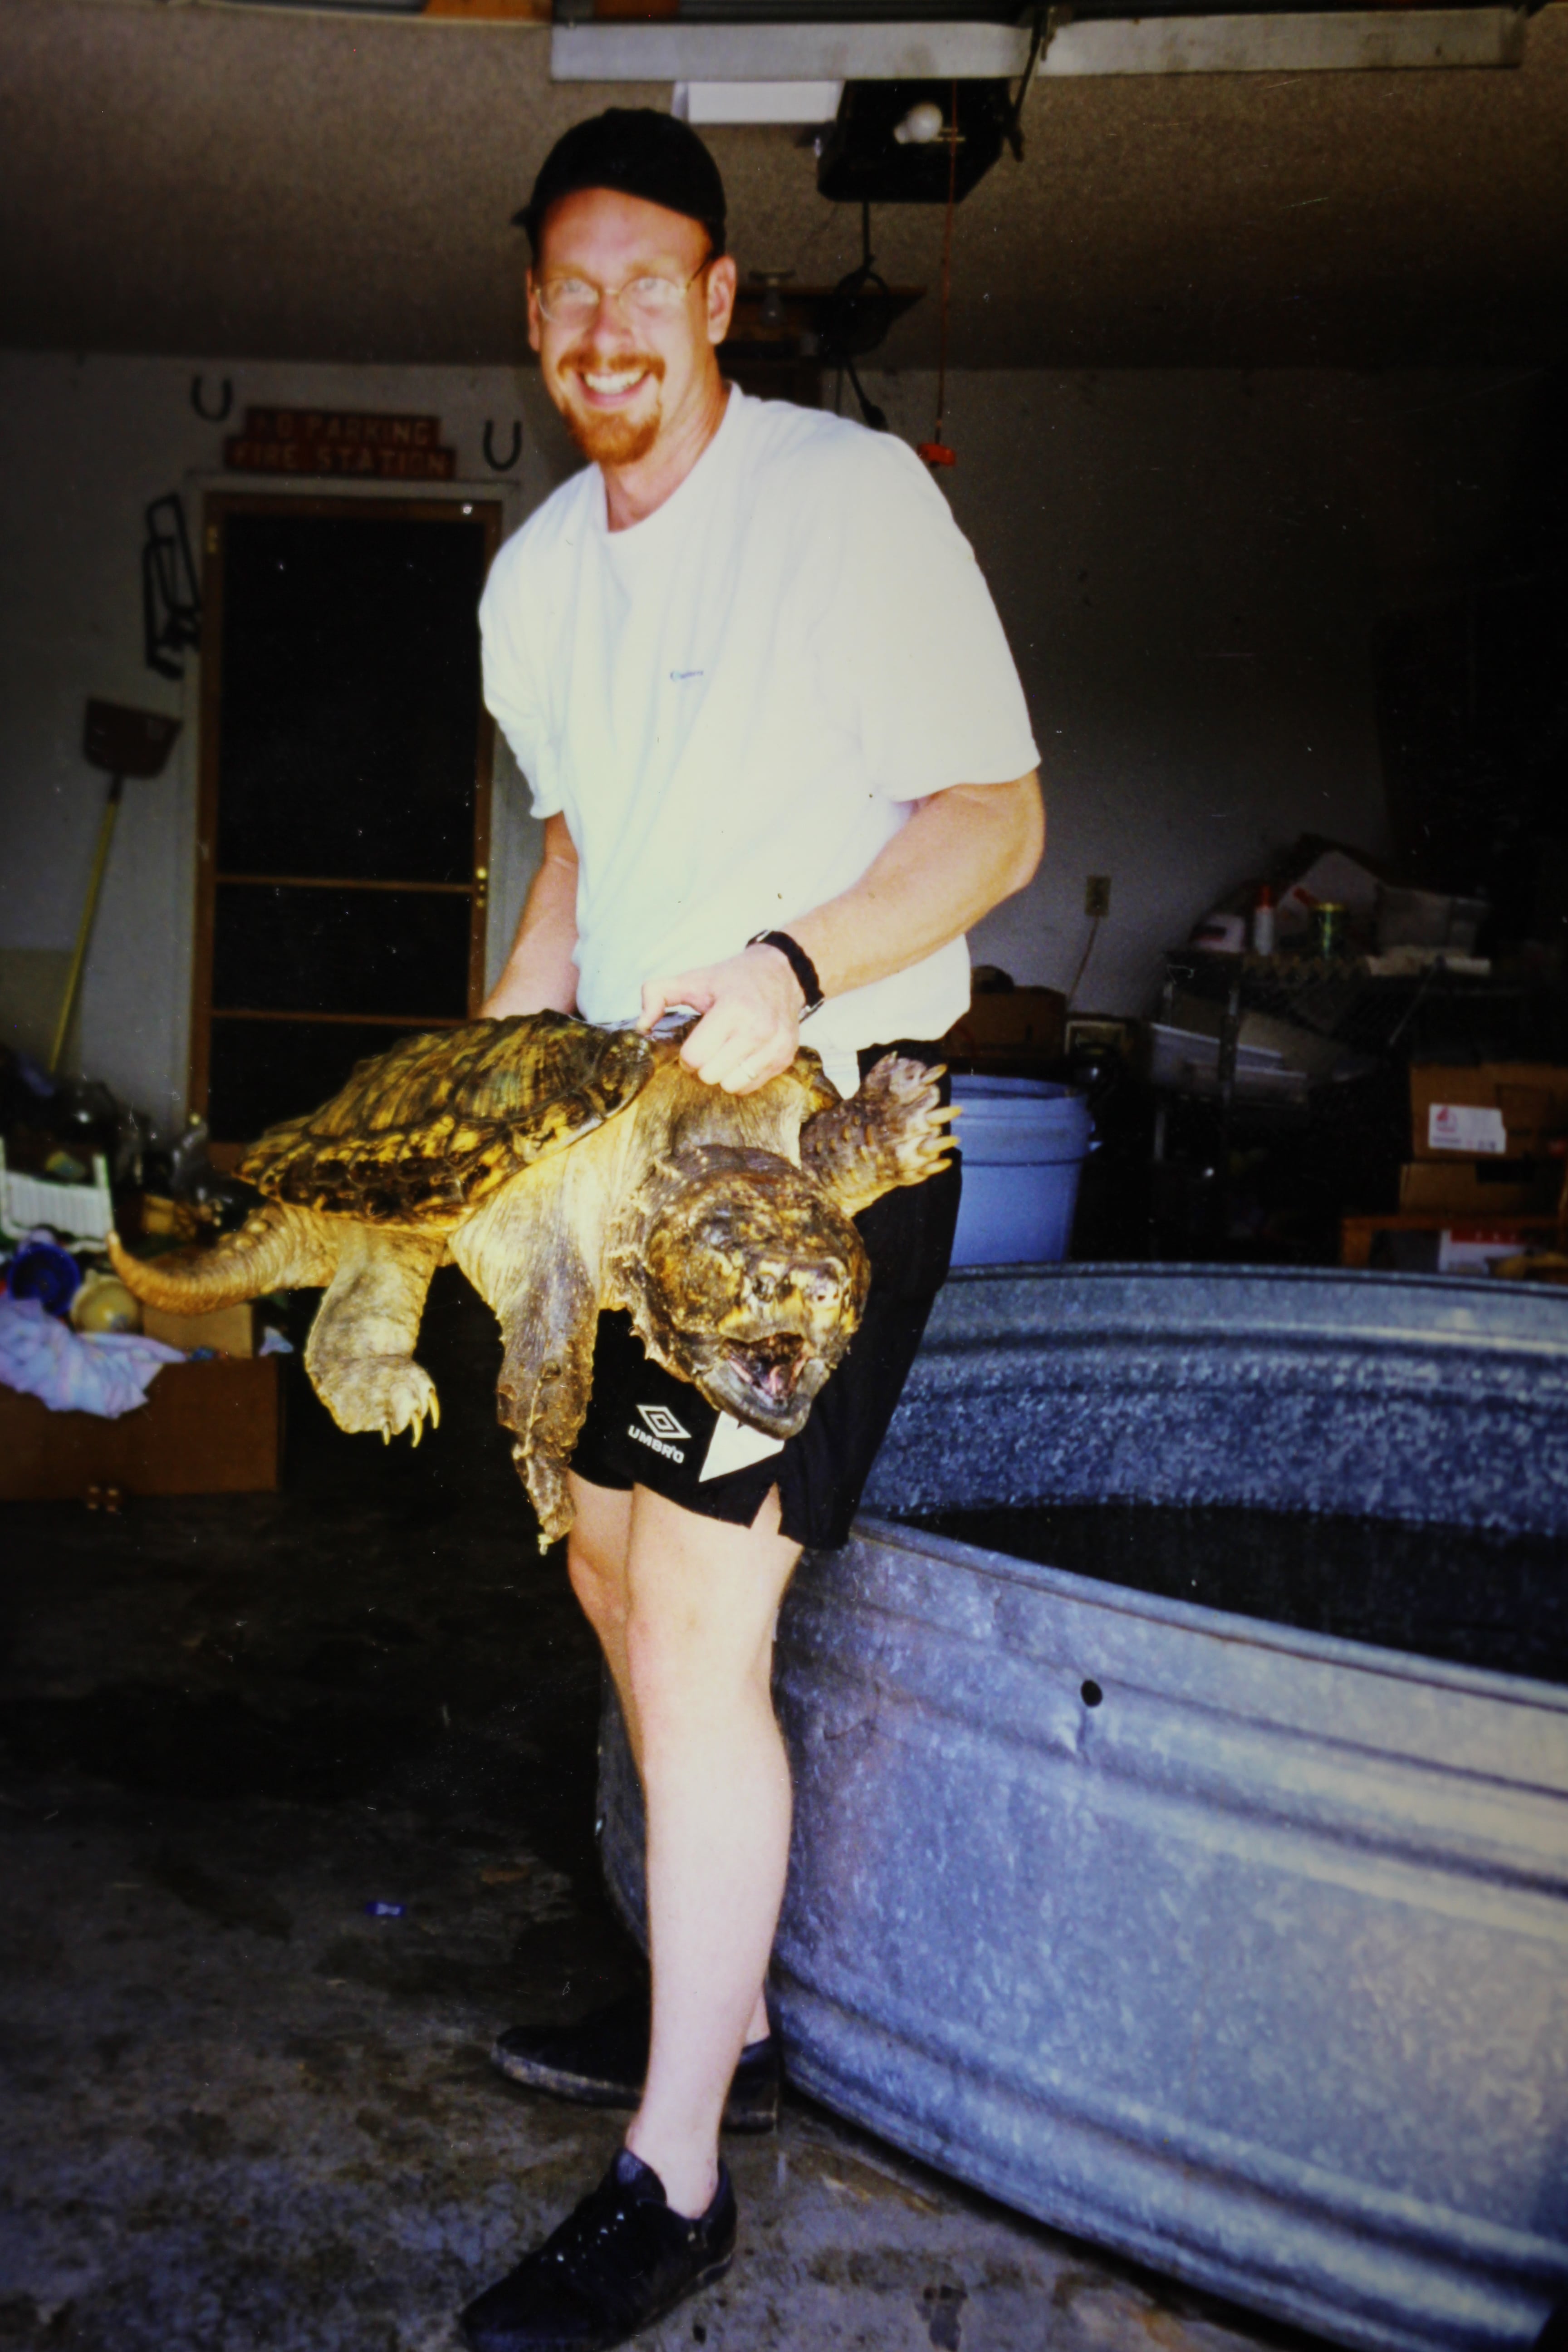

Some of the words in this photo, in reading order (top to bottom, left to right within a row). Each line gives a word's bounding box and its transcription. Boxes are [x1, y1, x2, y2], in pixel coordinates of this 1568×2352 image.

[254, 413, 294, 439] O
[305, 414, 430, 446] PARKING
[232, 442, 299, 470] FIRE
[317, 444, 449, 476] STATION
[627, 1424, 685, 1464] UMBRO
